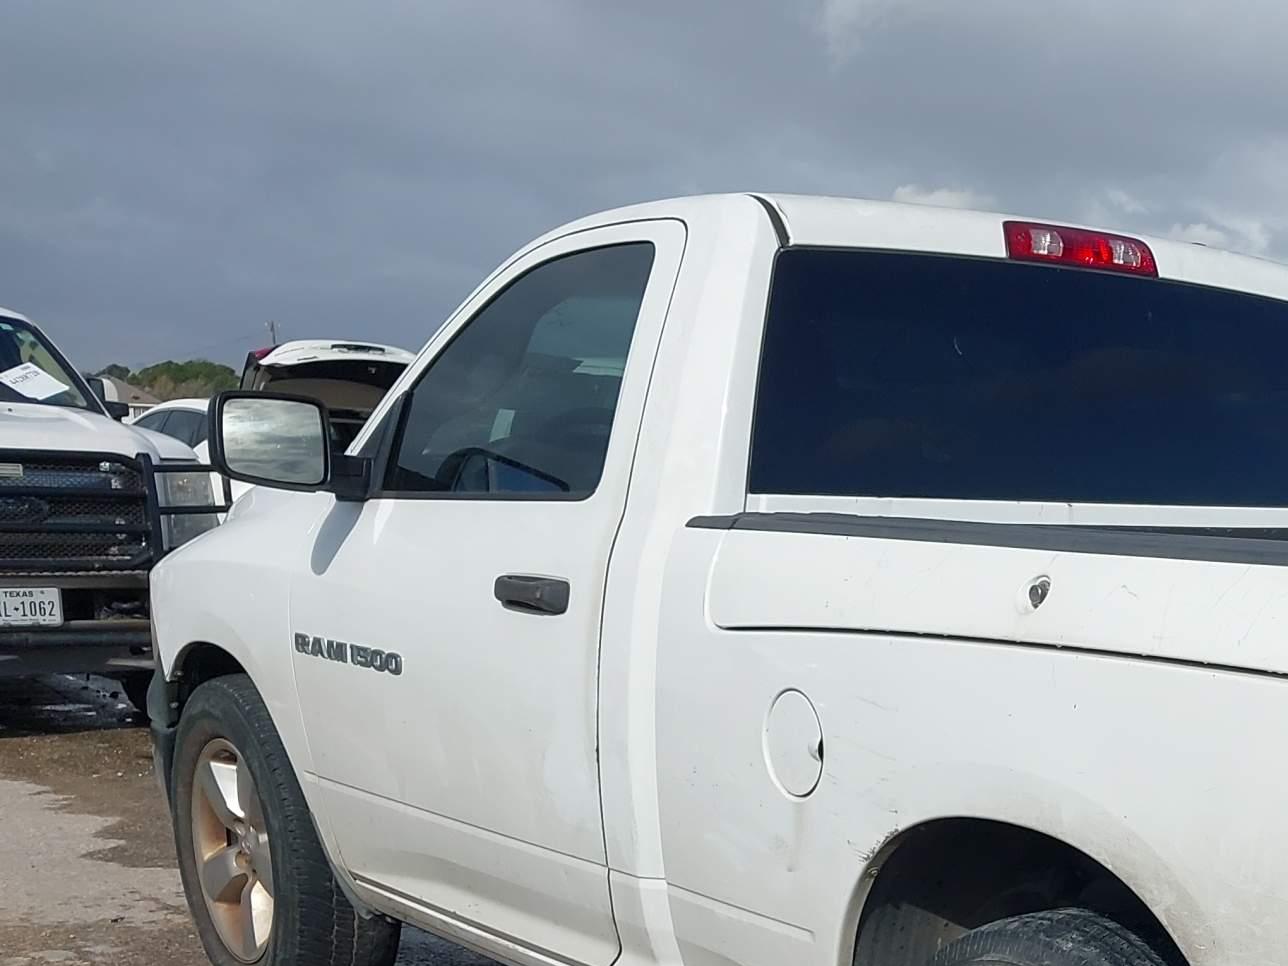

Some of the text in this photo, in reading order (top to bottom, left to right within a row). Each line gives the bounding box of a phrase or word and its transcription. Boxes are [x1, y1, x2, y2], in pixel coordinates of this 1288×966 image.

[3, 590, 34, 598] TEXAS
[294, 632, 403, 676] RAM 1500
